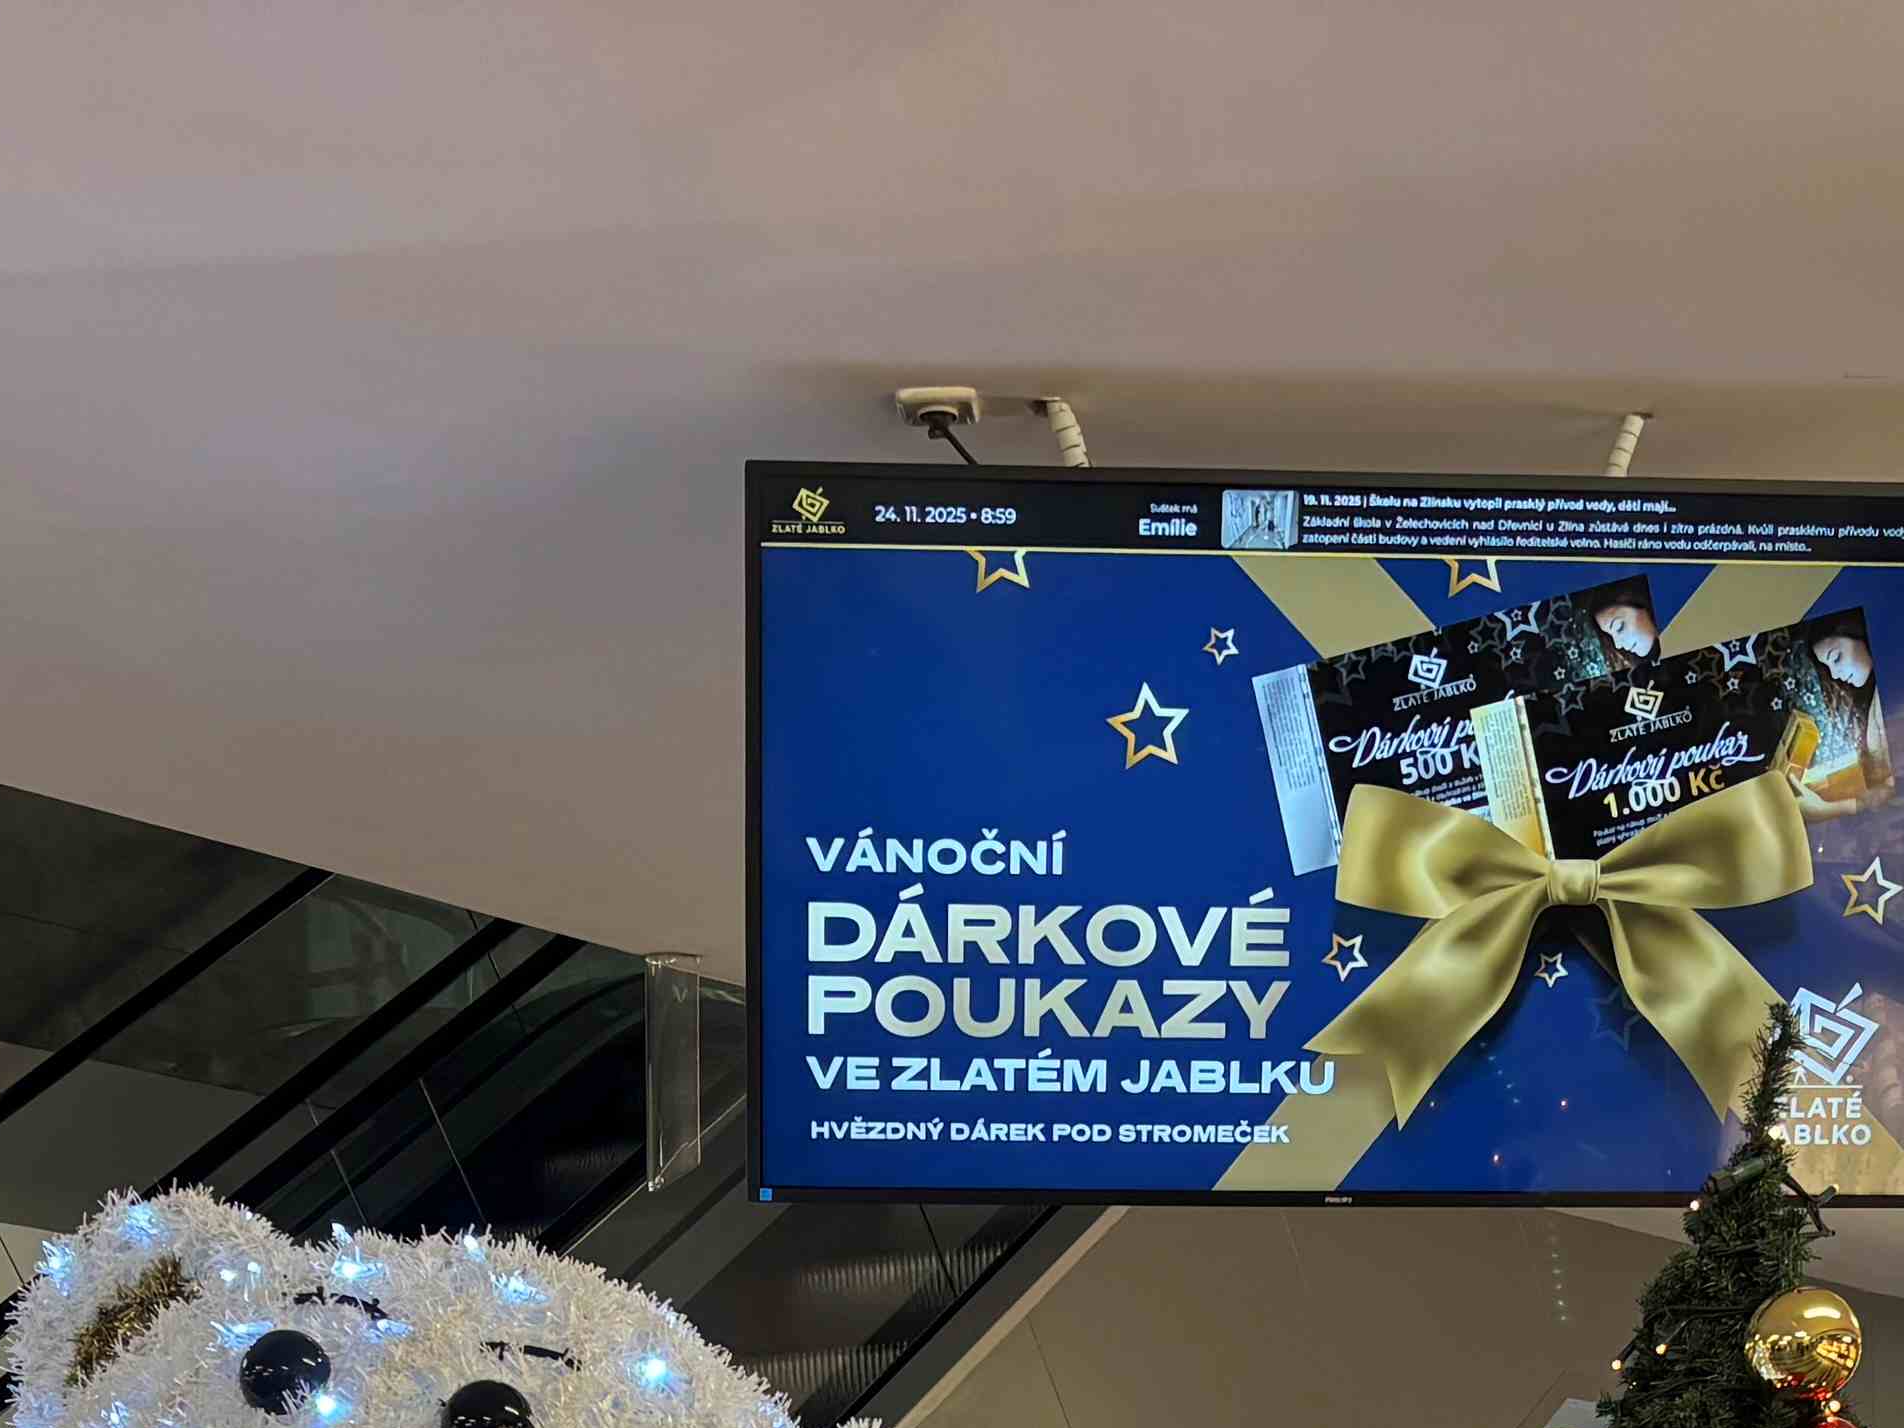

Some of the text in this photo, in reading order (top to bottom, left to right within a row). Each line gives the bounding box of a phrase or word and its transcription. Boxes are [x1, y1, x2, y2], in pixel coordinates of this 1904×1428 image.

[874, 505, 1017, 525] 24. 11. 2025 8:59
[1334, 495, 1362, 507] 2025
[1403, 497, 1417, 508] na
[1392, 678, 1477, 712] ZLATÉ JABLKO
[1328, 714, 1457, 769] Dárkový
[1609, 711, 1693, 744] ZLATÉ JABLKO
[1399, 751, 1454, 786] 500
[1462, 742, 1481, 769] K
[1545, 746, 1669, 800] Dárkový
[1668, 721, 1765, 779] poukaz
[1603, 762, 1727, 819] 1.000 Kč
[805, 827, 1067, 877] VÁNOČNÍ
[807, 883, 1291, 968] DÁRKOVÉ
[807, 975, 1292, 1039] POUKAZY
[805, 1048, 1335, 1095] VE ZLATÉM JABLKU
[810, 1116, 1290, 1144] HVĚZDNÝ DÁREK POD STROMEČEK
